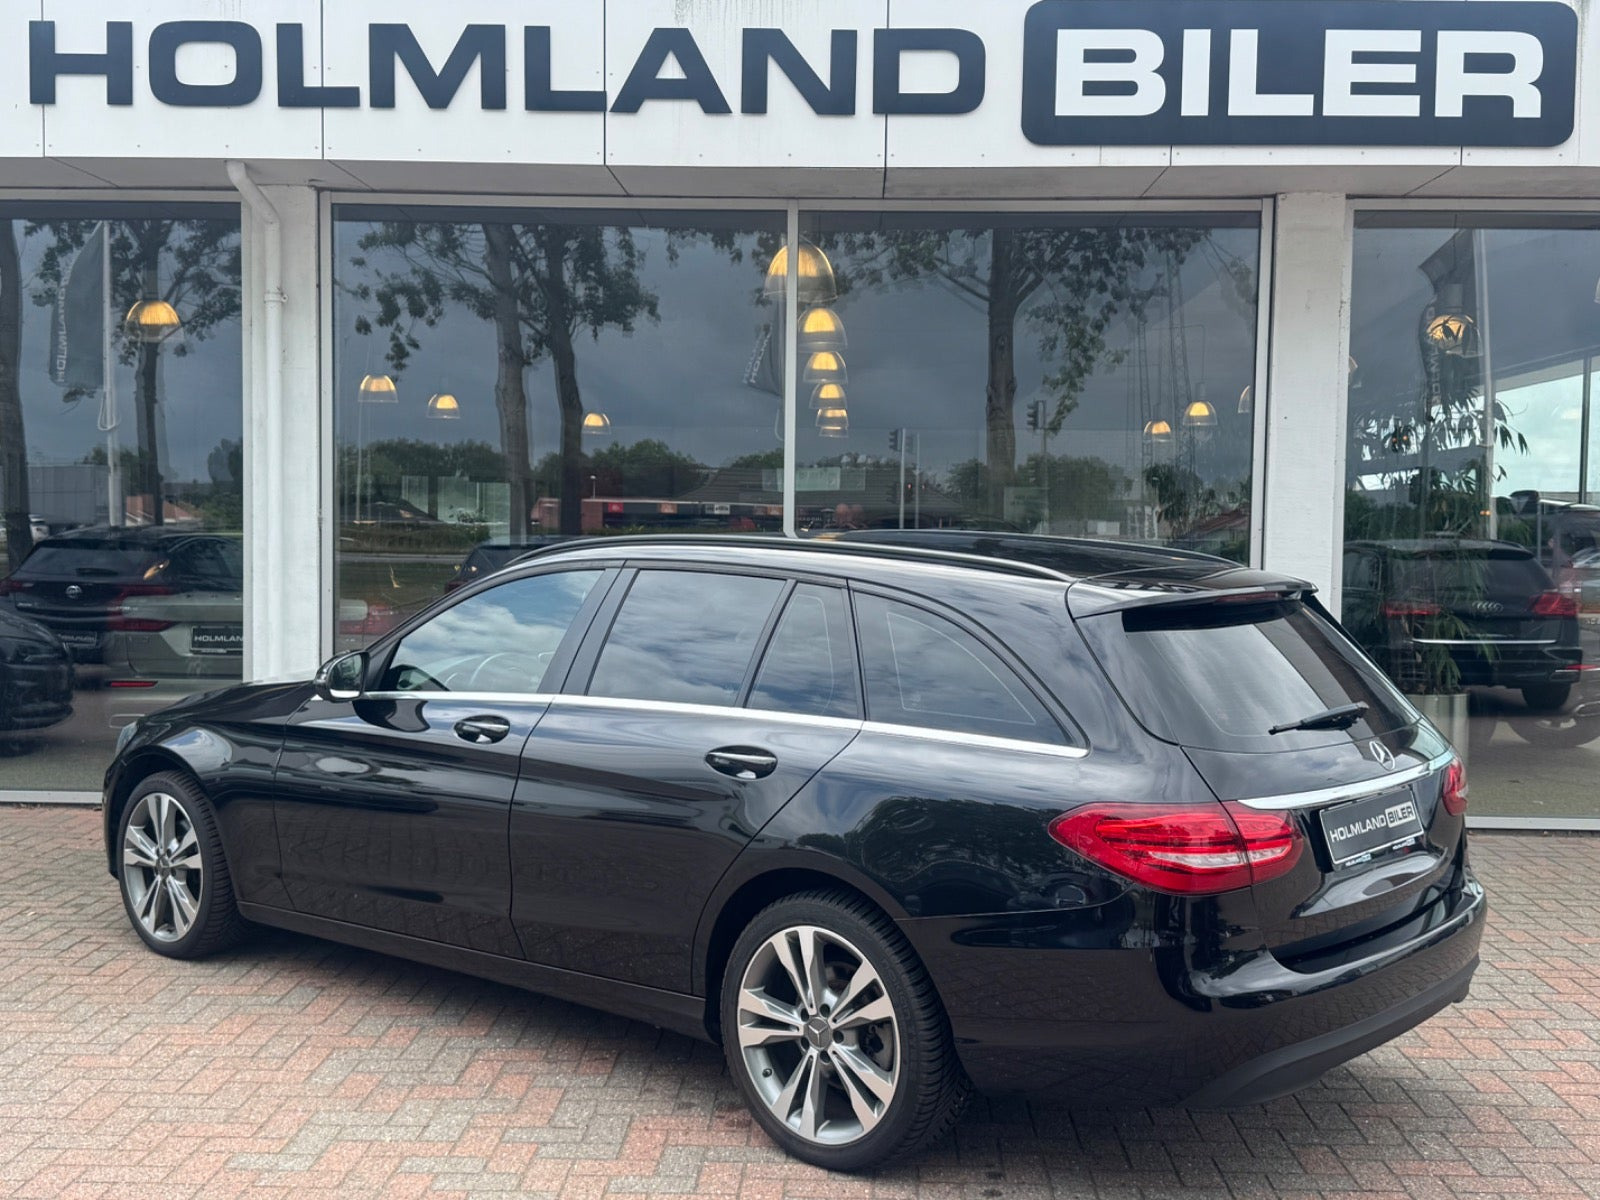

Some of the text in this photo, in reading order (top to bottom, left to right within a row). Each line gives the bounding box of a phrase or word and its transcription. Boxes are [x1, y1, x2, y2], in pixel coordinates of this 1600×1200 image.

[29, 20, 1544, 118] HOLMLAND BILER
[56, 287, 67, 382] HOLMLAND
[1329, 805, 1414, 843] HOLMLAND BILER
